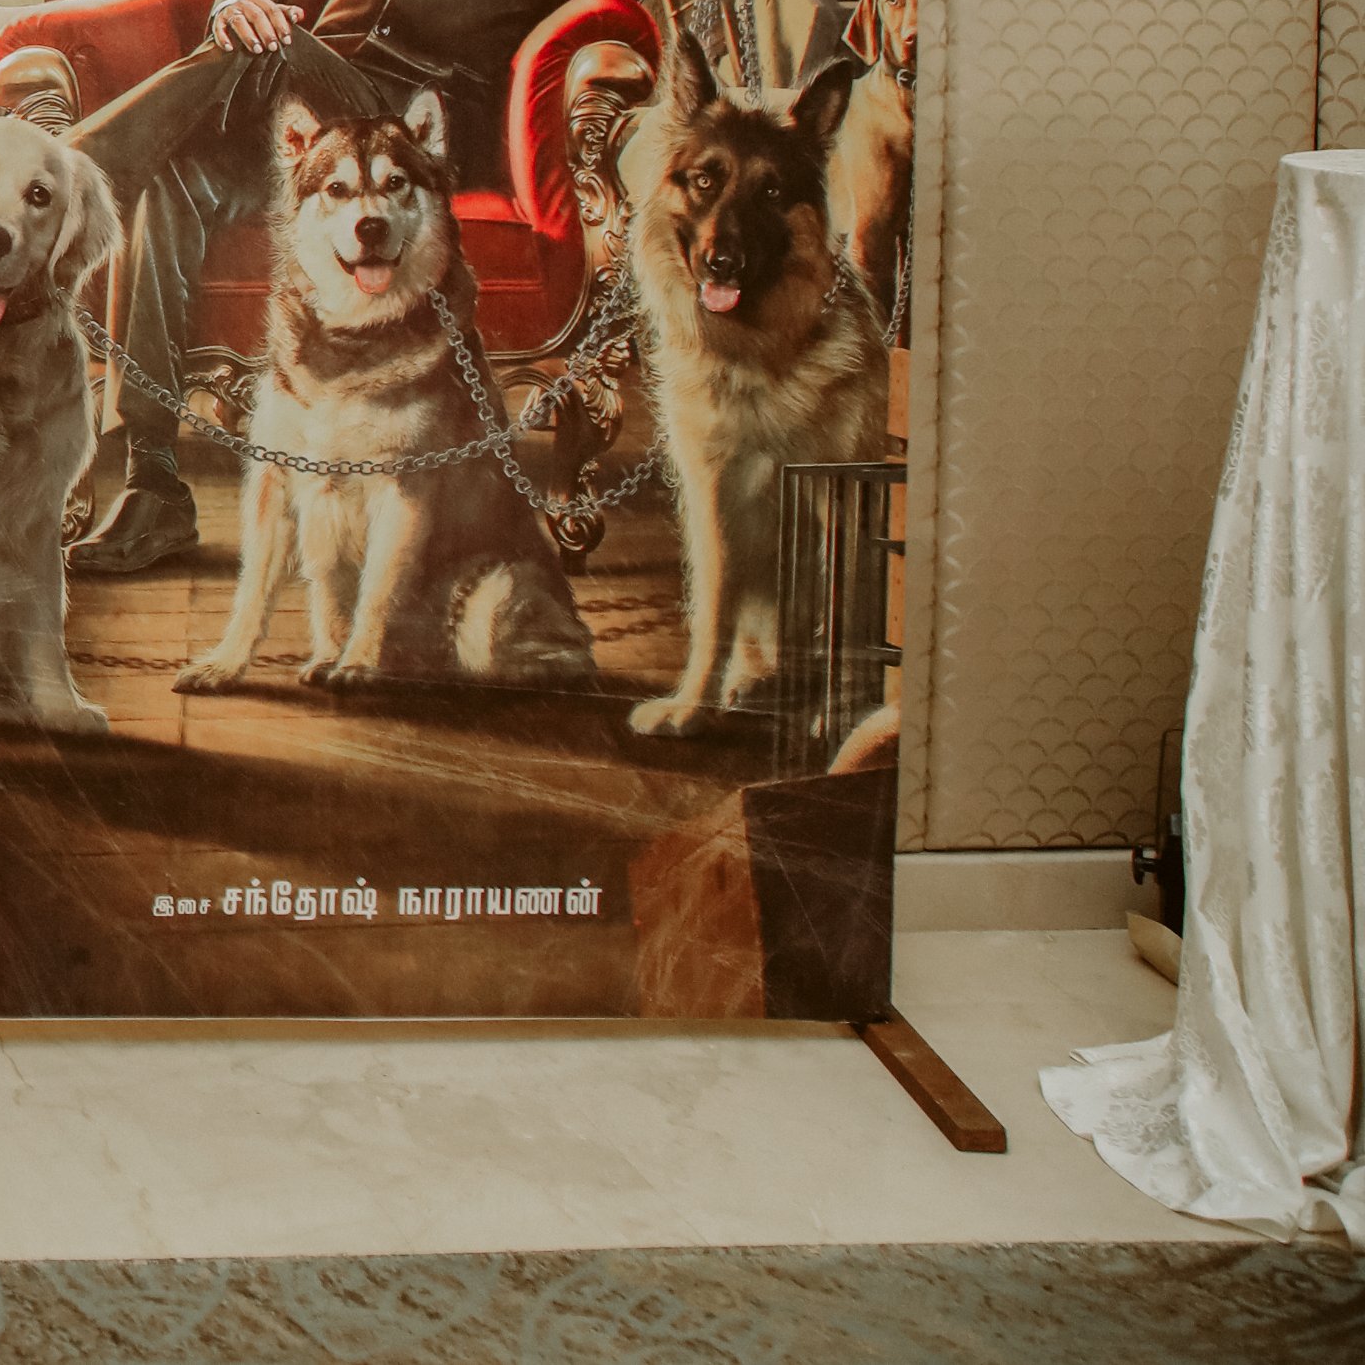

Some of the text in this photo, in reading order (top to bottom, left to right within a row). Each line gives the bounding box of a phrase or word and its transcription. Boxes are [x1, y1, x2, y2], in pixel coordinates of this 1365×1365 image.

[152, 877, 603, 921] இசை சந்தோஷ் நாராயணன்
